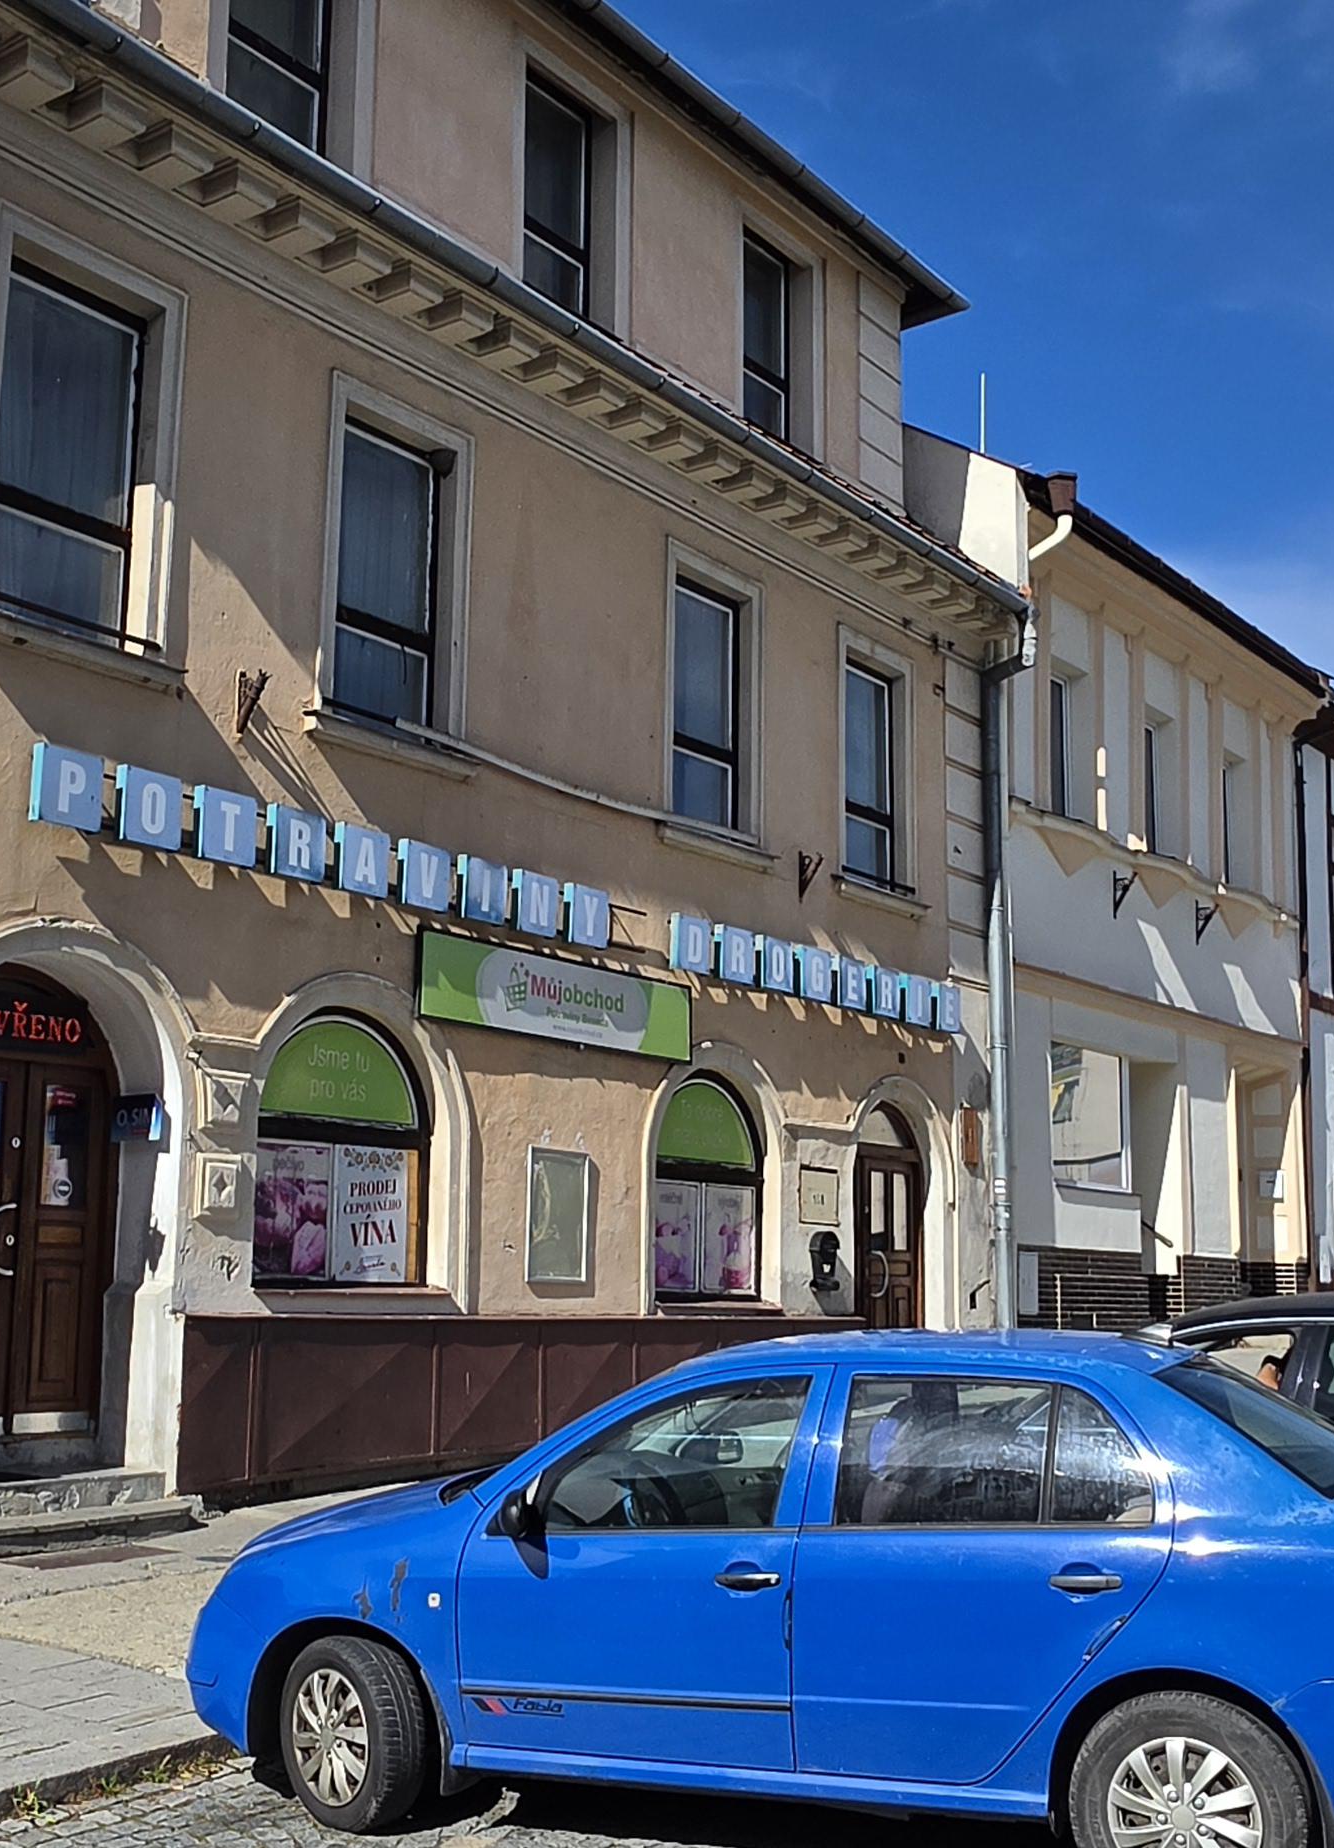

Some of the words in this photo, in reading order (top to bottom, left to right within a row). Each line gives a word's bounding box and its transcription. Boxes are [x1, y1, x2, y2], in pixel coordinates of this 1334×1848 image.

[57, 759, 599, 937] POTRAVINY
[687, 924, 956, 1026] DROGERIE
[307, 1044, 349, 1070] Jsme
[356, 1051, 370, 1074] tu
[309, 1078, 336, 1101] pro
[340, 1078, 367, 1102] vás
[349, 1178, 398, 1198] PRODEJ
[349, 1213, 397, 1248] VÍNA
